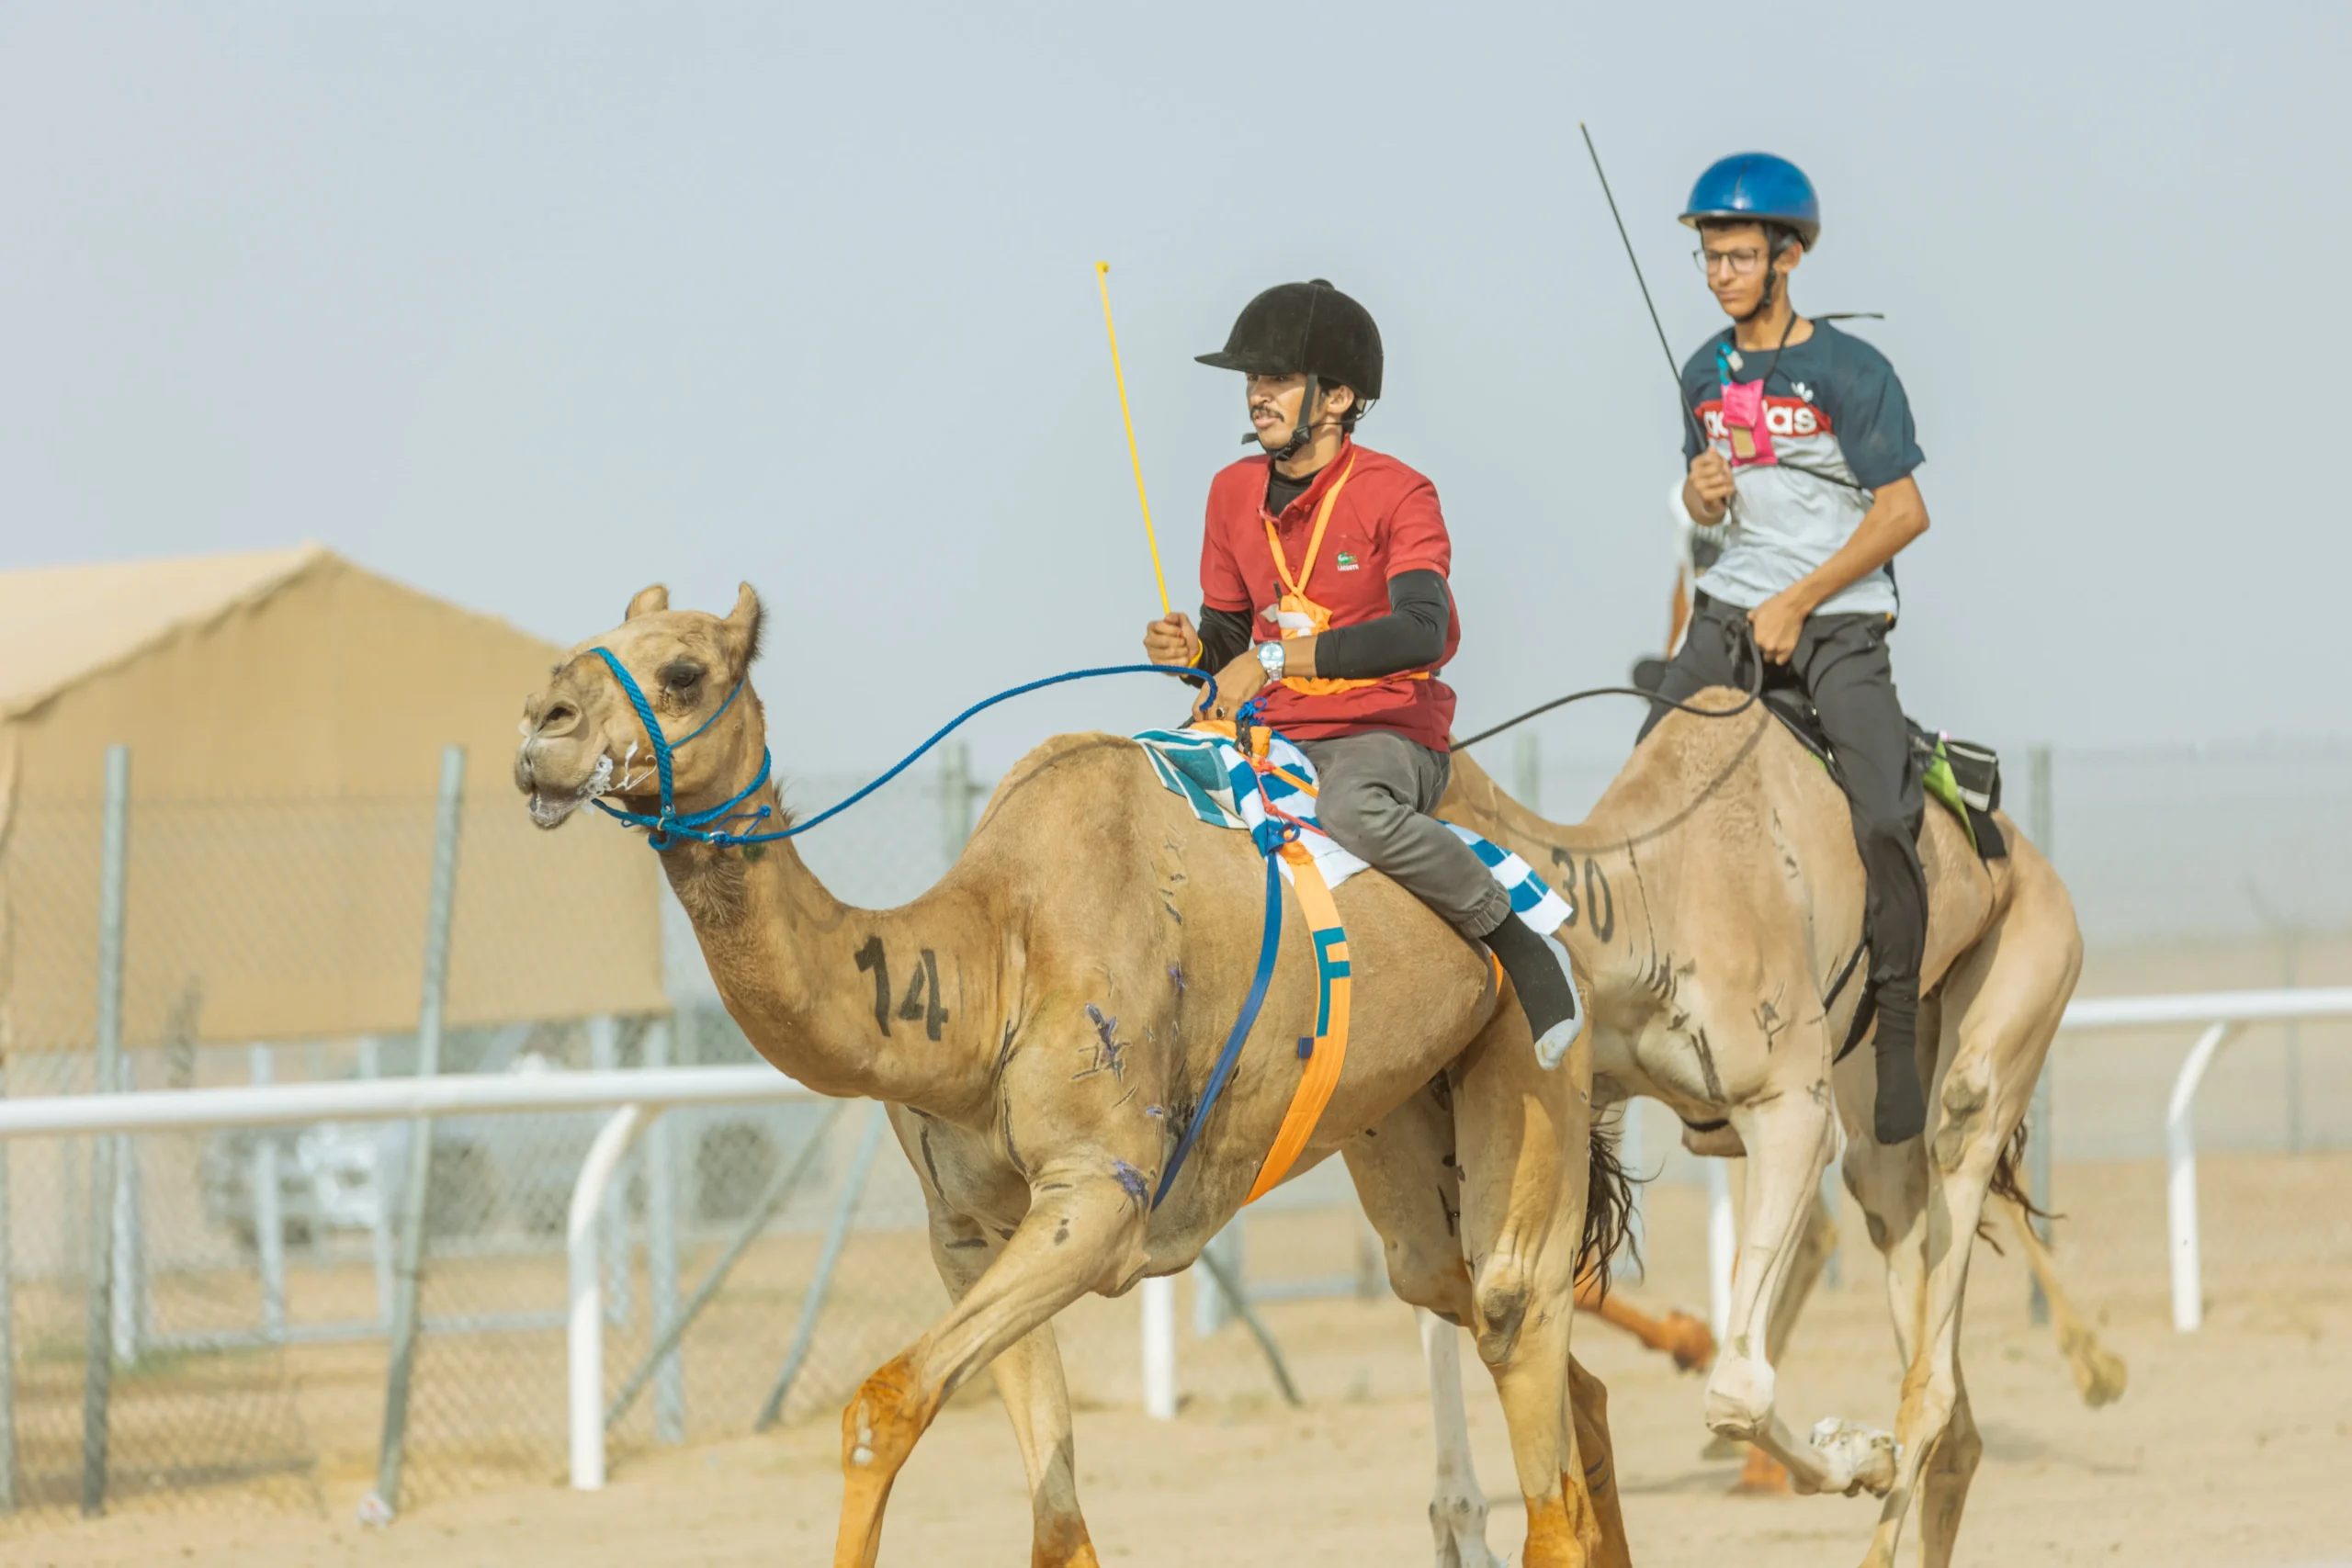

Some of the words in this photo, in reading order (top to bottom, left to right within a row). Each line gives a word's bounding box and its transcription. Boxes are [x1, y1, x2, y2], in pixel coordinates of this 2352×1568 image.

[1703, 399, 1817, 435] aas
[1552, 846, 1614, 943] 30
[854, 933, 949, 1041] 14
